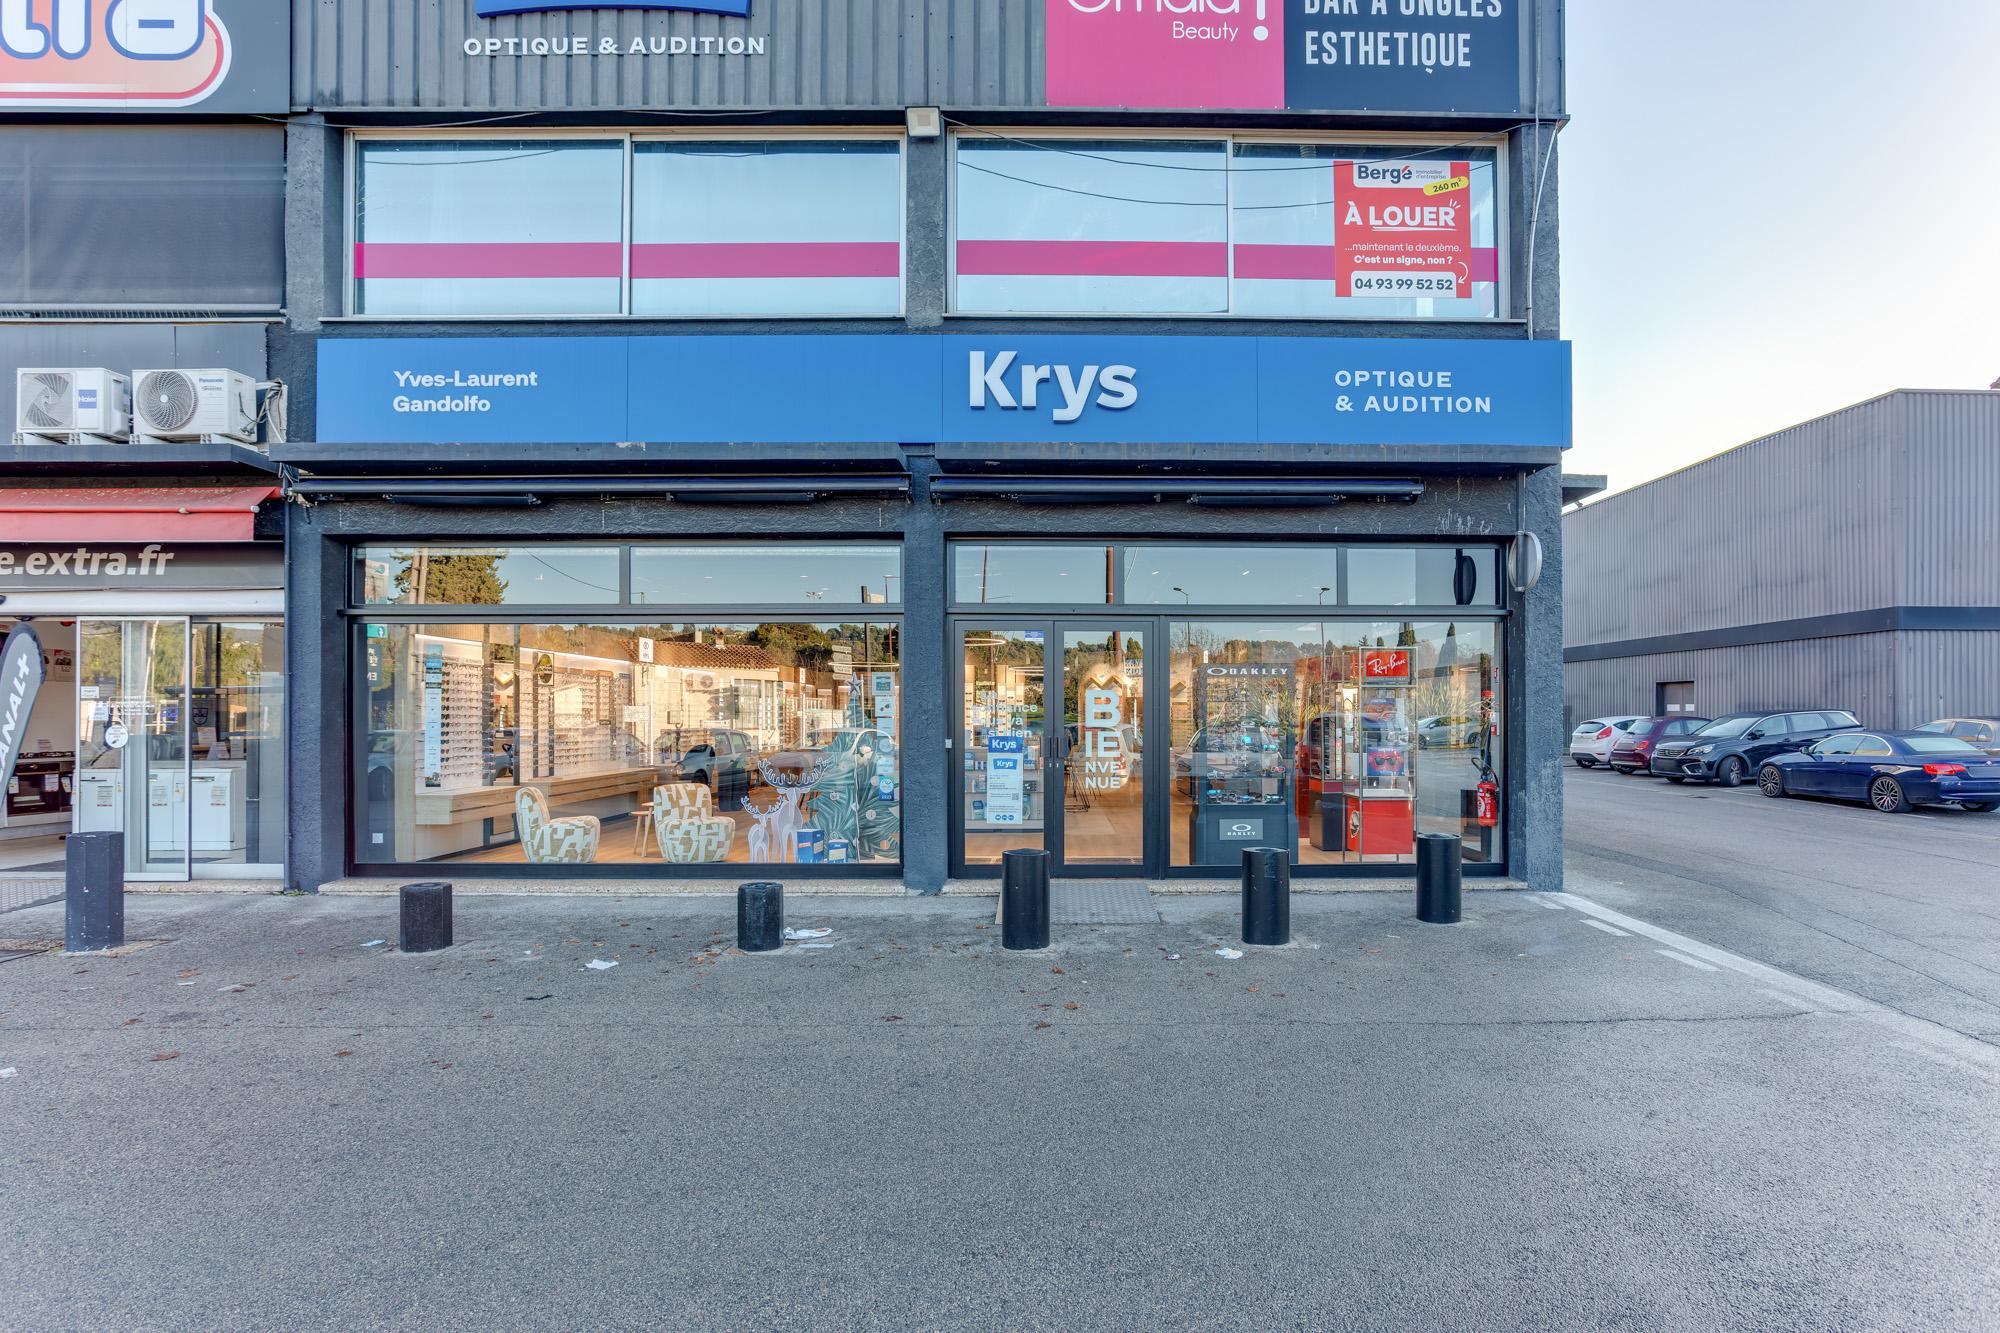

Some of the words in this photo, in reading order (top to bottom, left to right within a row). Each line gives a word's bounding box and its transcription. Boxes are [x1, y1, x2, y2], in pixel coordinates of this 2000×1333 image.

[1172, 21, 1239, 41] Beauty
[463, 37, 588, 55] OPTIQUE
[598, 37, 618, 55] &
[628, 37, 765, 54] AUDITION
[1305, 31, 1471, 73] ESTHETIQUE
[1358, 165, 1412, 184] Bergé
[1433, 183, 1449, 192] 260
[1344, 200, 1363, 225] À
[1369, 206, 1456, 227] LOUER
[1405, 243, 1413, 252] le
[1354, 255, 1380, 264] C'est
[1382, 256, 1395, 264] un
[1396, 255, 1425, 266] signe,
[1427, 256, 1445, 264] non
[1447, 256, 1453, 264] ?
[1354, 278, 1373, 289] 04
[1375, 278, 1393, 289] 93
[1395, 278, 1413, 290] 99
[1416, 279, 1434, 290] 52
[1436, 279, 1453, 290] 52
[393, 370, 538, 387] Yves-Laurent
[969, 350, 1138, 423] Krys
[1334, 370, 1452, 388] OPTIQUE
[393, 395, 491, 412] Gandolfo
[1335, 395, 1354, 412] &
[1364, 395, 1491, 413] AUDITION
[1229, 667, 1288, 675] OAKLEY
[1009, 717, 1024, 726] va
[992, 739, 1017, 750] Krys
